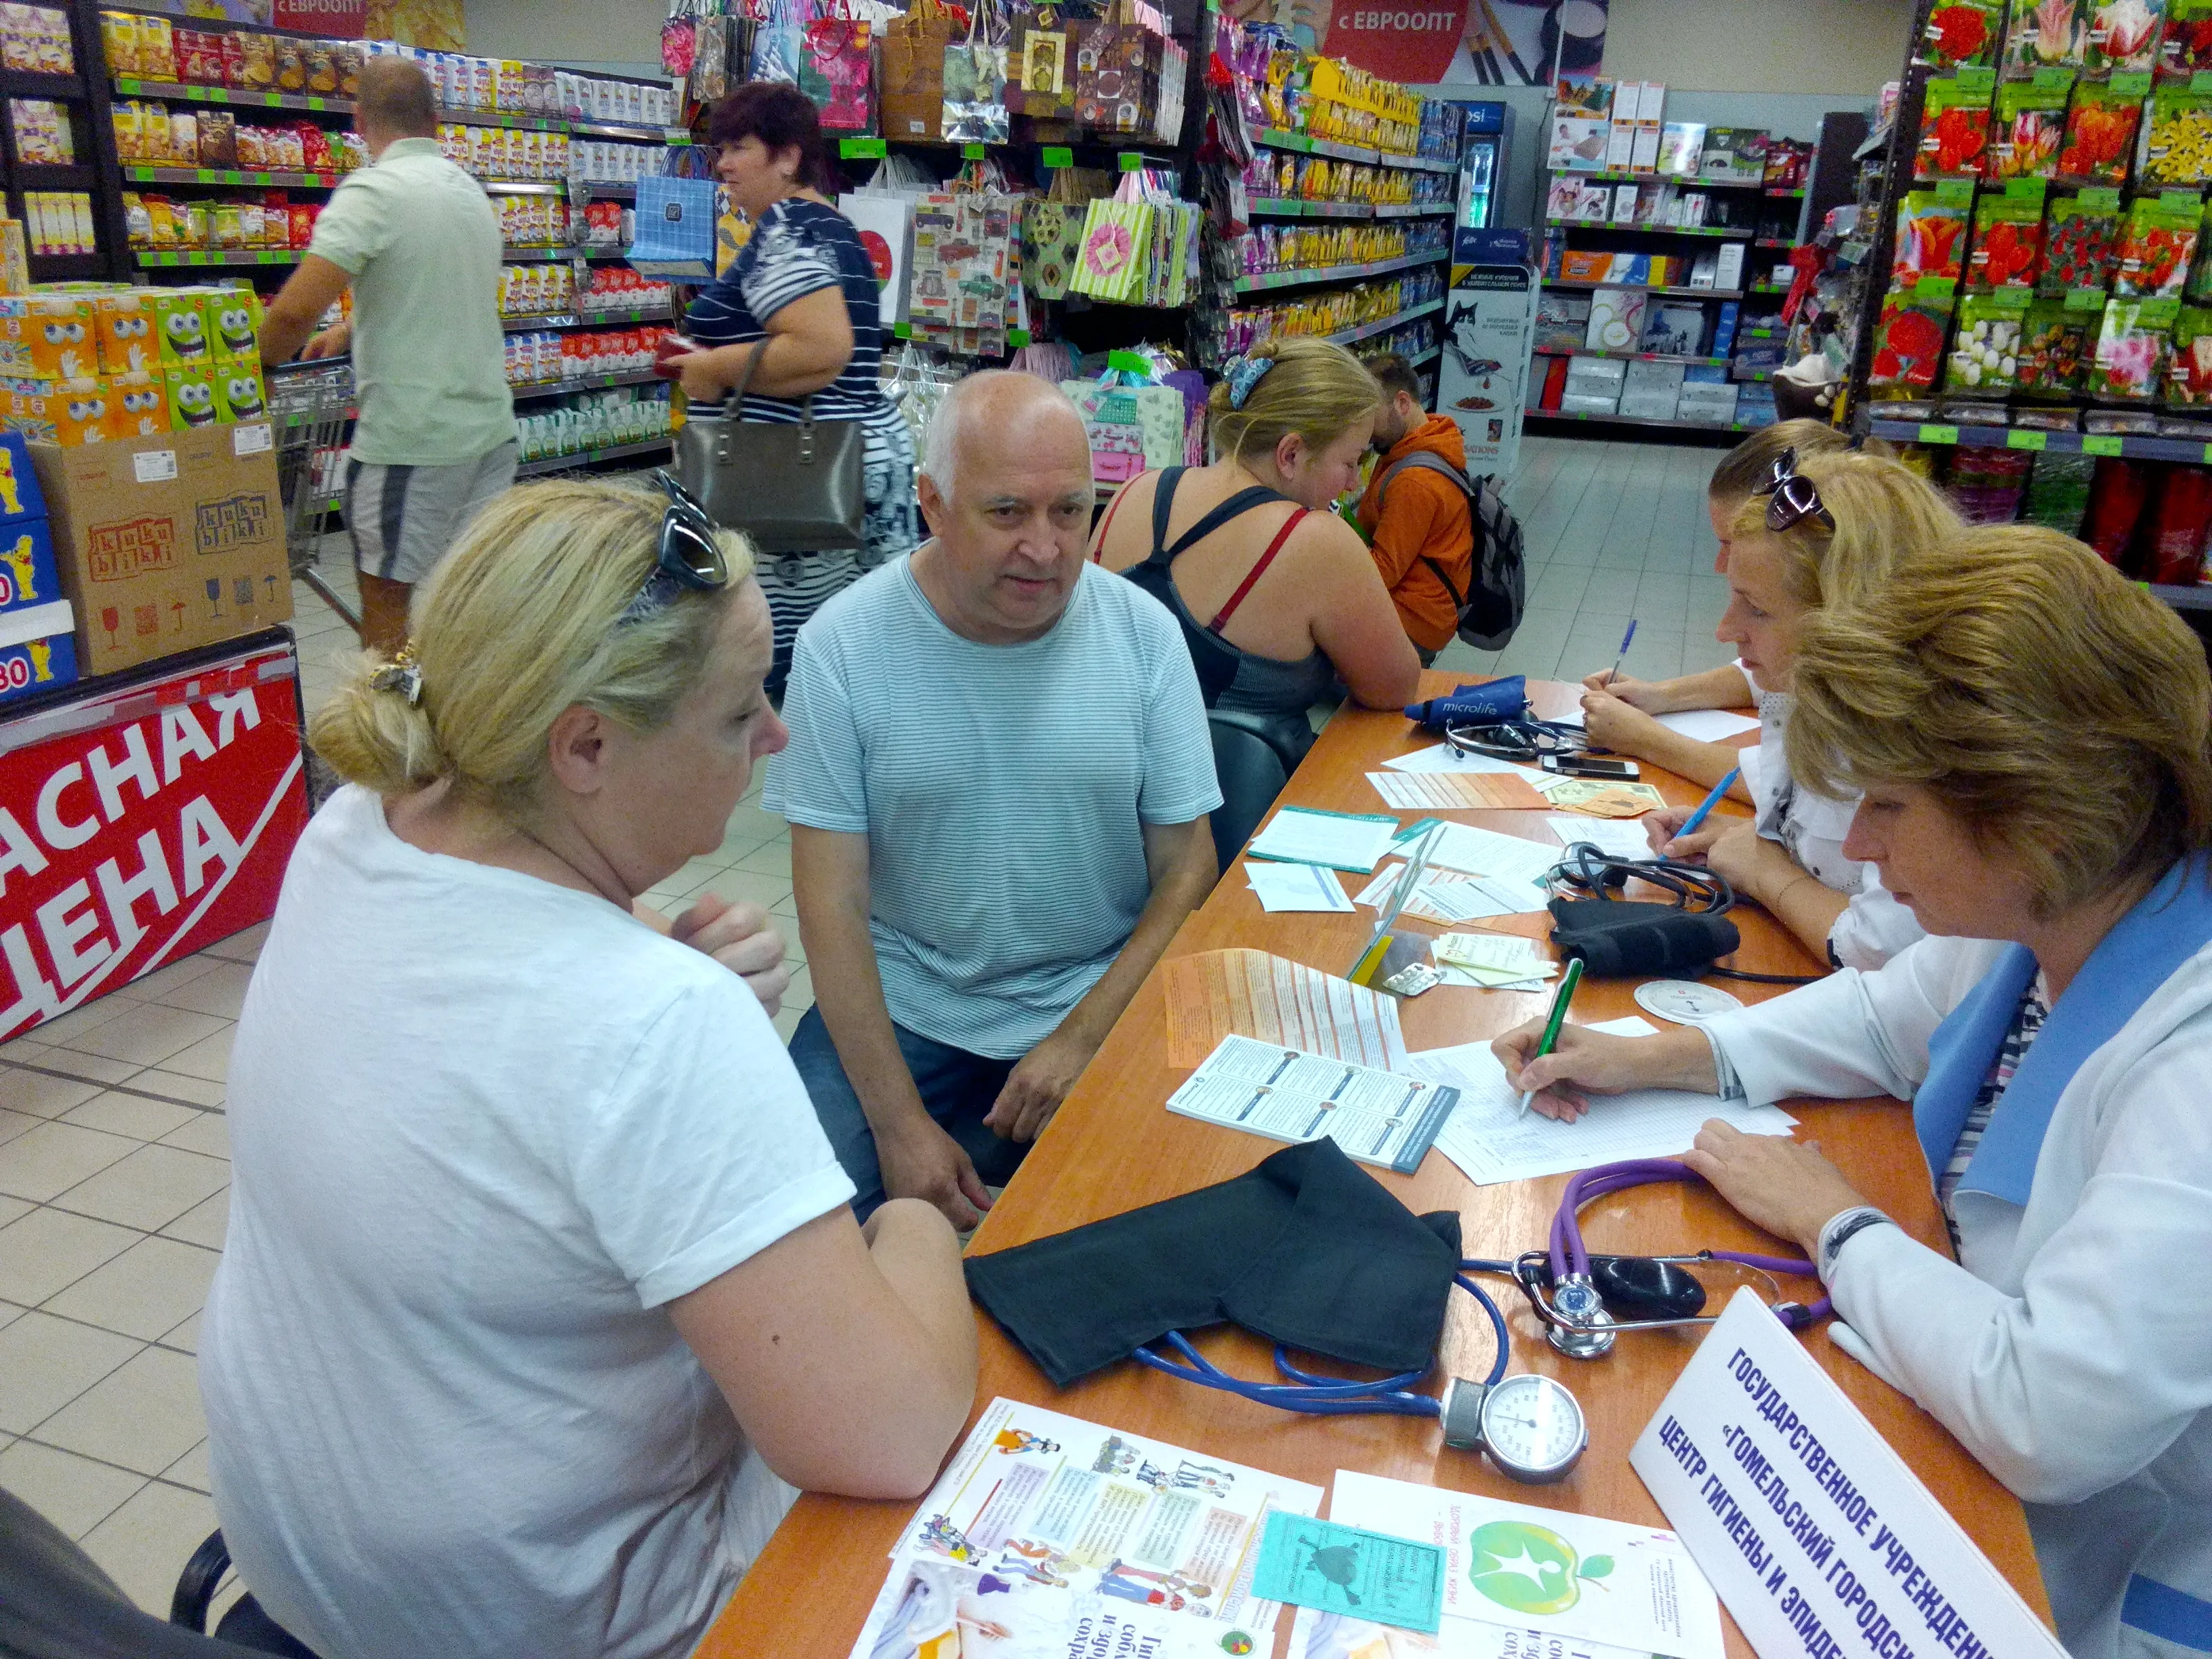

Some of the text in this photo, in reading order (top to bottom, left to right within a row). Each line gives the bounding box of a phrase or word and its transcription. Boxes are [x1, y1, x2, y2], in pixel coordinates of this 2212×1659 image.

[1354, 11, 1456, 31] ЕВРООПТ
[1441, 700, 1498, 716] microlife
[1727, 1347, 1878, 1537] ГОСУДАРСТВЕННОЕ
[1658, 1415, 1707, 1479] ЦЕНТР
[1700, 1474, 1774, 1576] ГИГИЕНЫ
[1765, 1564, 1788, 1597] И
[1721, 1422, 1837, 1570] «ГОМЕЛЬСКИЙ
[1448, 1548, 1459, 1574] ОБРАЗ
[1447, 1576, 1458, 1605] ЖИЗНИ
[1102, 1614, 1118, 1625] и
